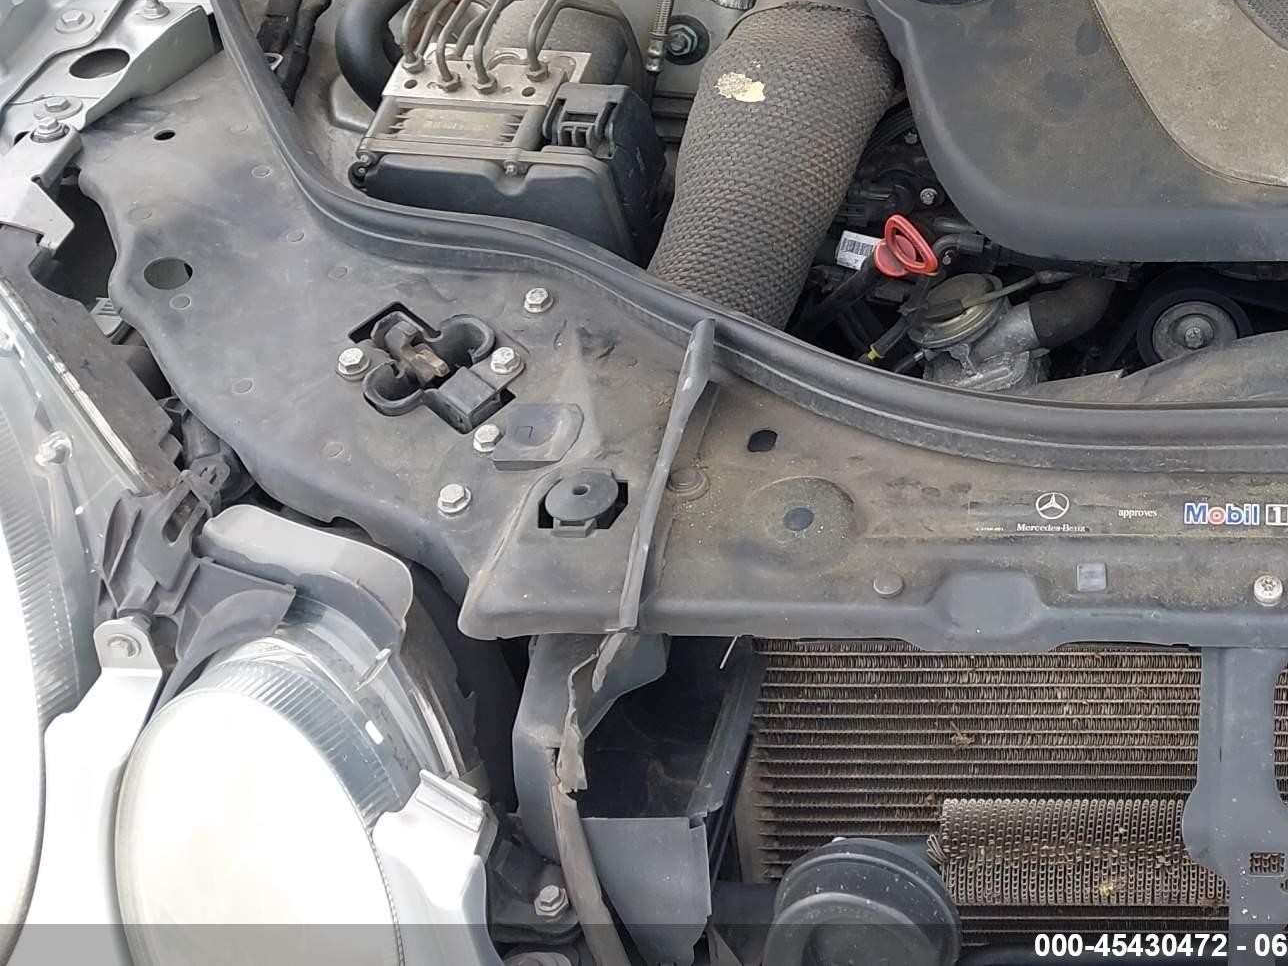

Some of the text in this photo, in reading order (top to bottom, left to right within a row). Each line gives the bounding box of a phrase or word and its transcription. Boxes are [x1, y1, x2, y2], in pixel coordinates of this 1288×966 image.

[1118, 508, 1158, 518] approves
[1184, 502, 1260, 526] Mobil
[1016, 522, 1086, 532] Mercedes-Benz
